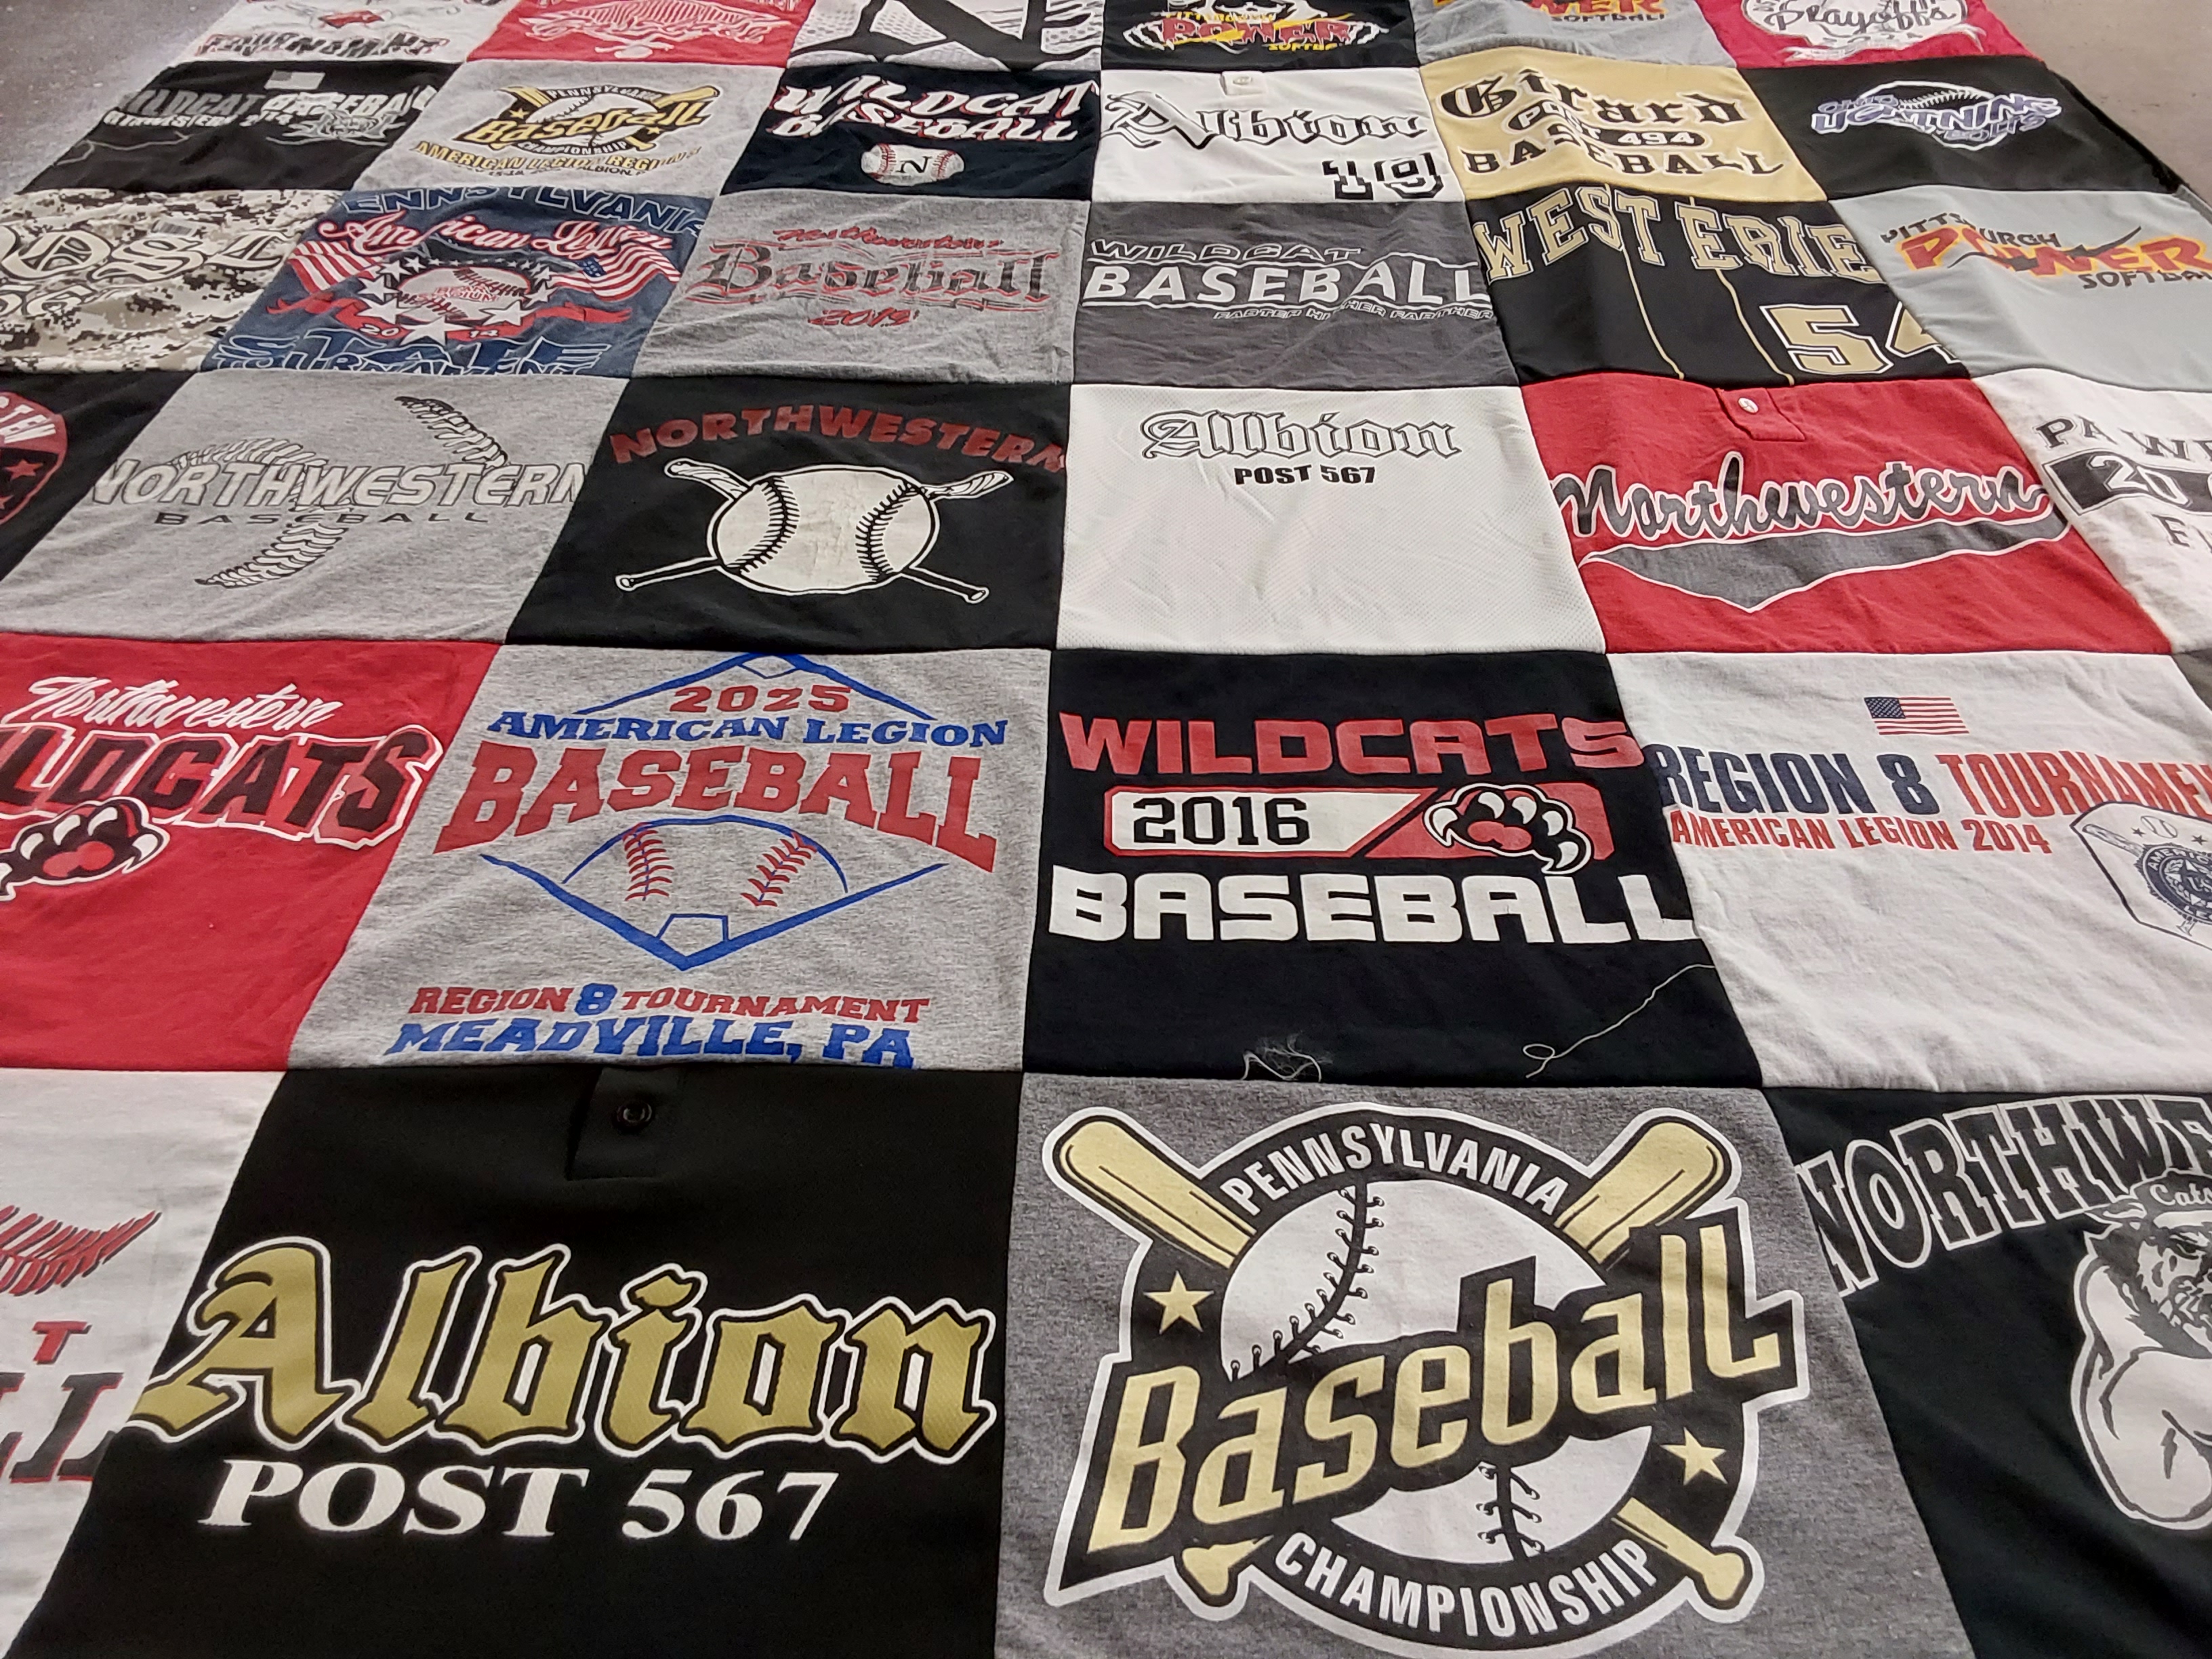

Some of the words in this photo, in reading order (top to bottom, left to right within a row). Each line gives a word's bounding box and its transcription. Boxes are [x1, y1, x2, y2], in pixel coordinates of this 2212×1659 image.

[1162, 18, 1351, 45] POWER
[768, 75, 1100, 117] WILDCAT
[1438, 67, 1750, 119] Girard
[464, 100, 710, 144] Baseball
[1103, 90, 1429, 150] Albion
[1519, 101, 1601, 141] POST
[1616, 131, 1696, 146] 494
[411, 140, 526, 171] AMERICAN
[896, 155, 933, 175] N
[340, 187, 705, 237] ENNSYLVANIA
[1473, 186, 1666, 285] WEST
[1674, 201, 1888, 285] ERIE
[1090, 238, 1362, 262] WILDCAT
[1083, 260, 1492, 305] BASEBALL
[218, 327, 613, 369] STATE
[359, 323, 401, 337] 20
[468, 329, 500, 339] 14
[610, 404, 1065, 472] NORTHWESTERN
[1139, 409, 1463, 459] Albion
[1234, 464, 1312, 485] POST
[1320, 464, 1376, 485] 567
[1549, 449, 2051, 542] Northwestern
[155, 511, 491, 525] BASEBALL
[3, 676, 345, 733] Northwestern
[670, 684, 853, 714] 2025
[487, 710, 789, 741] AMERICAN
[802, 718, 1009, 747] LEGION
[1059, 712, 1645, 777] WILDCATS
[433, 740, 998, 874] BASEBALL
[1643, 743, 1877, 815] REGION
[1876, 752, 1940, 815] 8
[1936, 750, 2212, 821] TOURNAME
[1132, 796, 1311, 846] 2016
[1671, 809, 1836, 851] AMERICAN
[1841, 817, 1960, 851] LEGION
[1961, 819, 2053, 855] 2014
[1048, 864, 1702, 945] BASEBALL
[409, 987, 573, 1015] REGION
[574, 983, 618, 1017] 8
[623, 988, 930, 1023] TOURNAMENT
[384, 1015, 805, 1064] MEADVILLE,
[823, 1022, 917, 1069] PA
[1224, 1121, 1570, 1217] PENNSYLVANIA
[125, 1234, 997, 1464] Albion
[1086, 1224, 1781, 1554] Baseball
[198, 1458, 590, 1539] POST
[619, 1467, 840, 1542] 567
[1273, 1530, 1660, 1639] CHAMPIONSHIP
